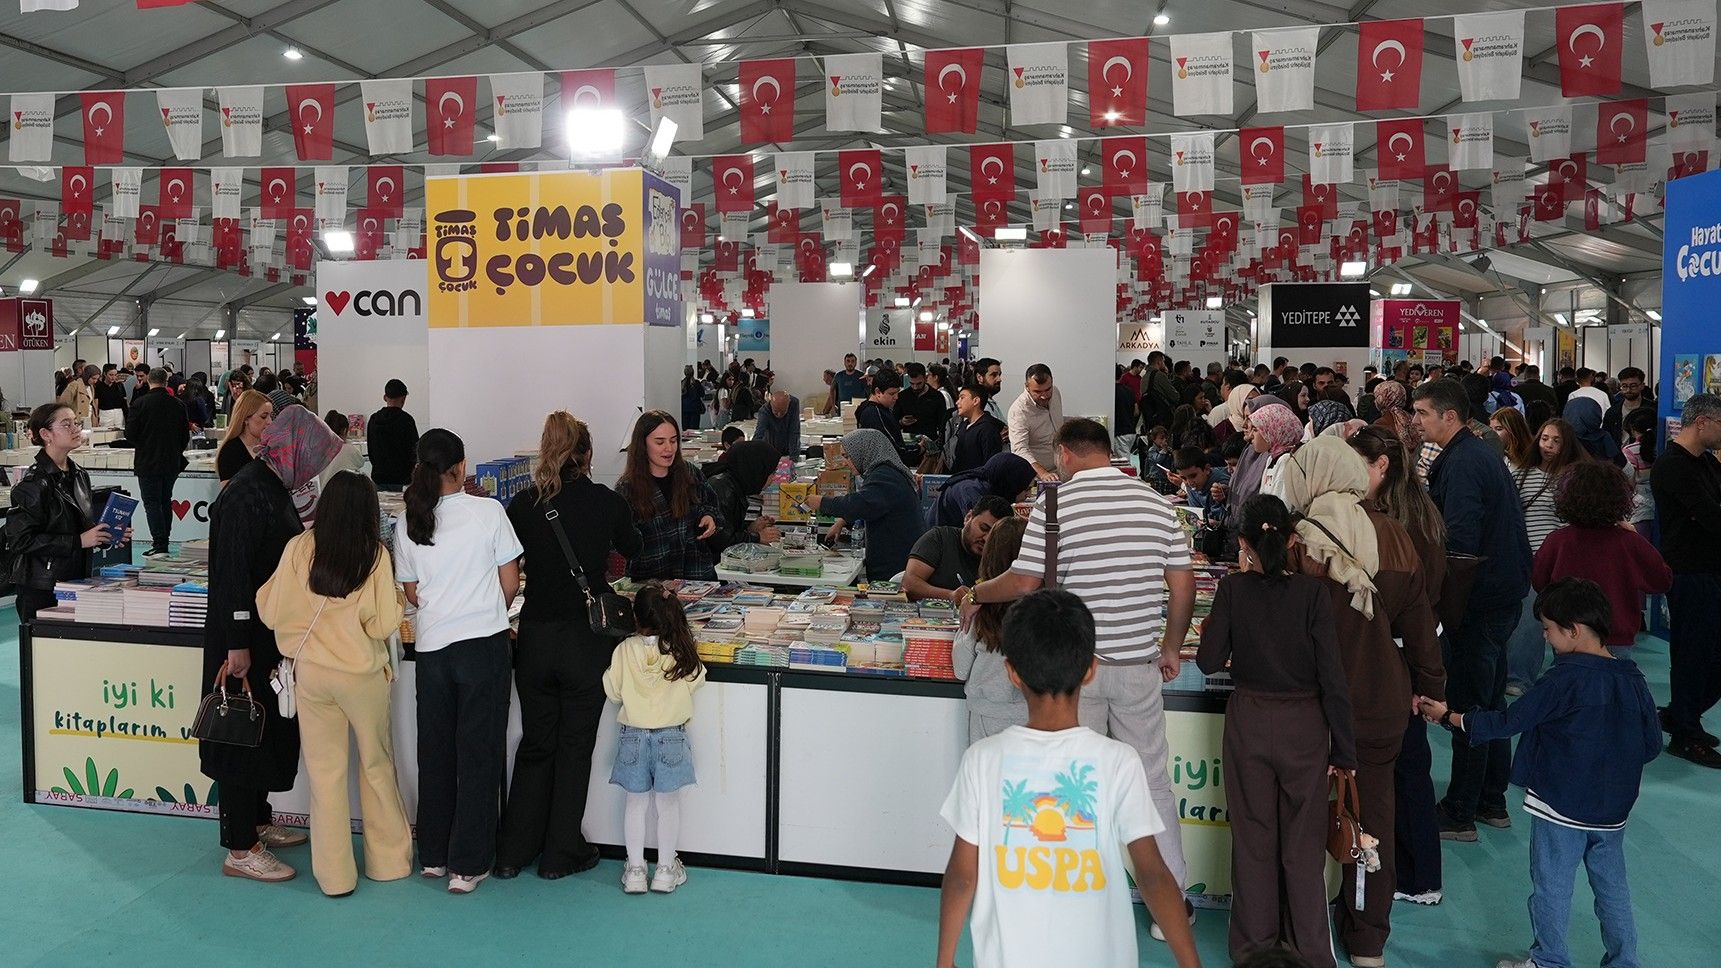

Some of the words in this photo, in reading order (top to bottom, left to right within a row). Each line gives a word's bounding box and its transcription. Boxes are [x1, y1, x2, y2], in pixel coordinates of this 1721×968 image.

[1692, 223, 1721, 246] Hayat
[486, 251, 635, 296] ÇOCUK
[646, 268, 678, 301] GÜLCE
[438, 280, 478, 294] ÇOCUK
[354, 289, 421, 316] can
[1282, 310, 1331, 324] YEDİTEPE
[23, 338, 48, 348] ÖTÜKEN
[874, 336, 896, 346] ekin
[103, 679, 137, 709] iyi
[151, 678, 175, 709] ki
[54, 710, 168, 740] kitaplarım
[1174, 756, 1221, 790] iyi
[46, 790, 83, 803] SARAY
[170, 802, 210, 814] SARAY
[994, 844, 1107, 892] USPA
